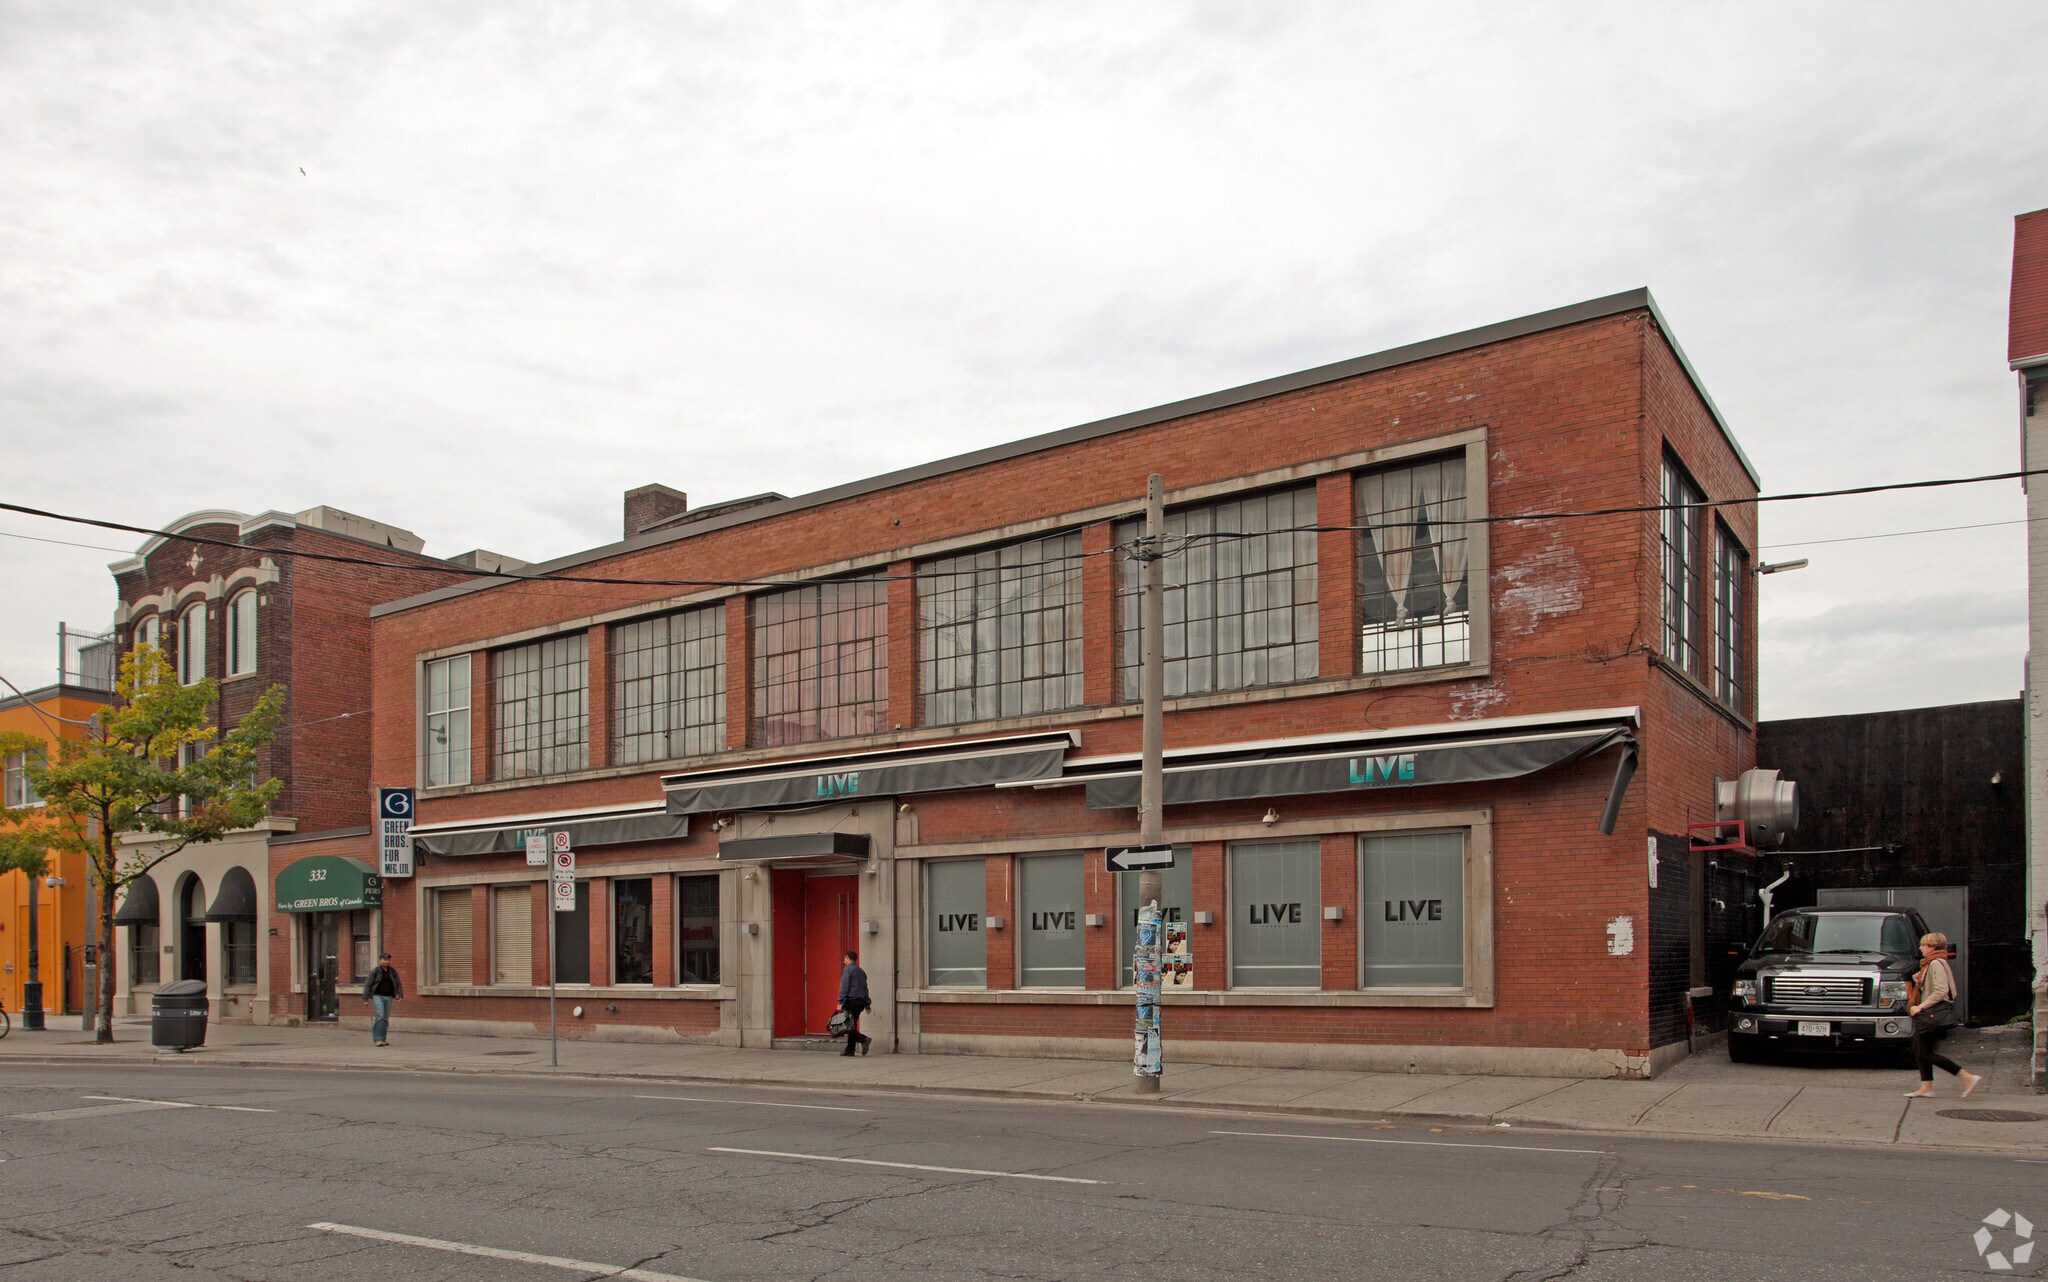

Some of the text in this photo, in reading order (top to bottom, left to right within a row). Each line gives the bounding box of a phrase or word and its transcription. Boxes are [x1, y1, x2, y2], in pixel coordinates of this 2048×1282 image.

[1349, 753, 1415, 783] LIVE
[817, 772, 859, 795] LIVE
[384, 821, 410, 834] GREEN
[384, 835, 409, 848] BROS.
[384, 849, 400, 862] FUR
[309, 869, 327, 882] 332
[384, 864, 410, 875] MFG. LTD.
[294, 898, 318, 908] GREEN
[318, 897, 339, 906] BROS
[1250, 903, 1302, 924] LIVE
[1384, 900, 1442, 922] LIVE
[939, 913, 978, 931] LIVE
[1032, 911, 1076, 930] LIVE
